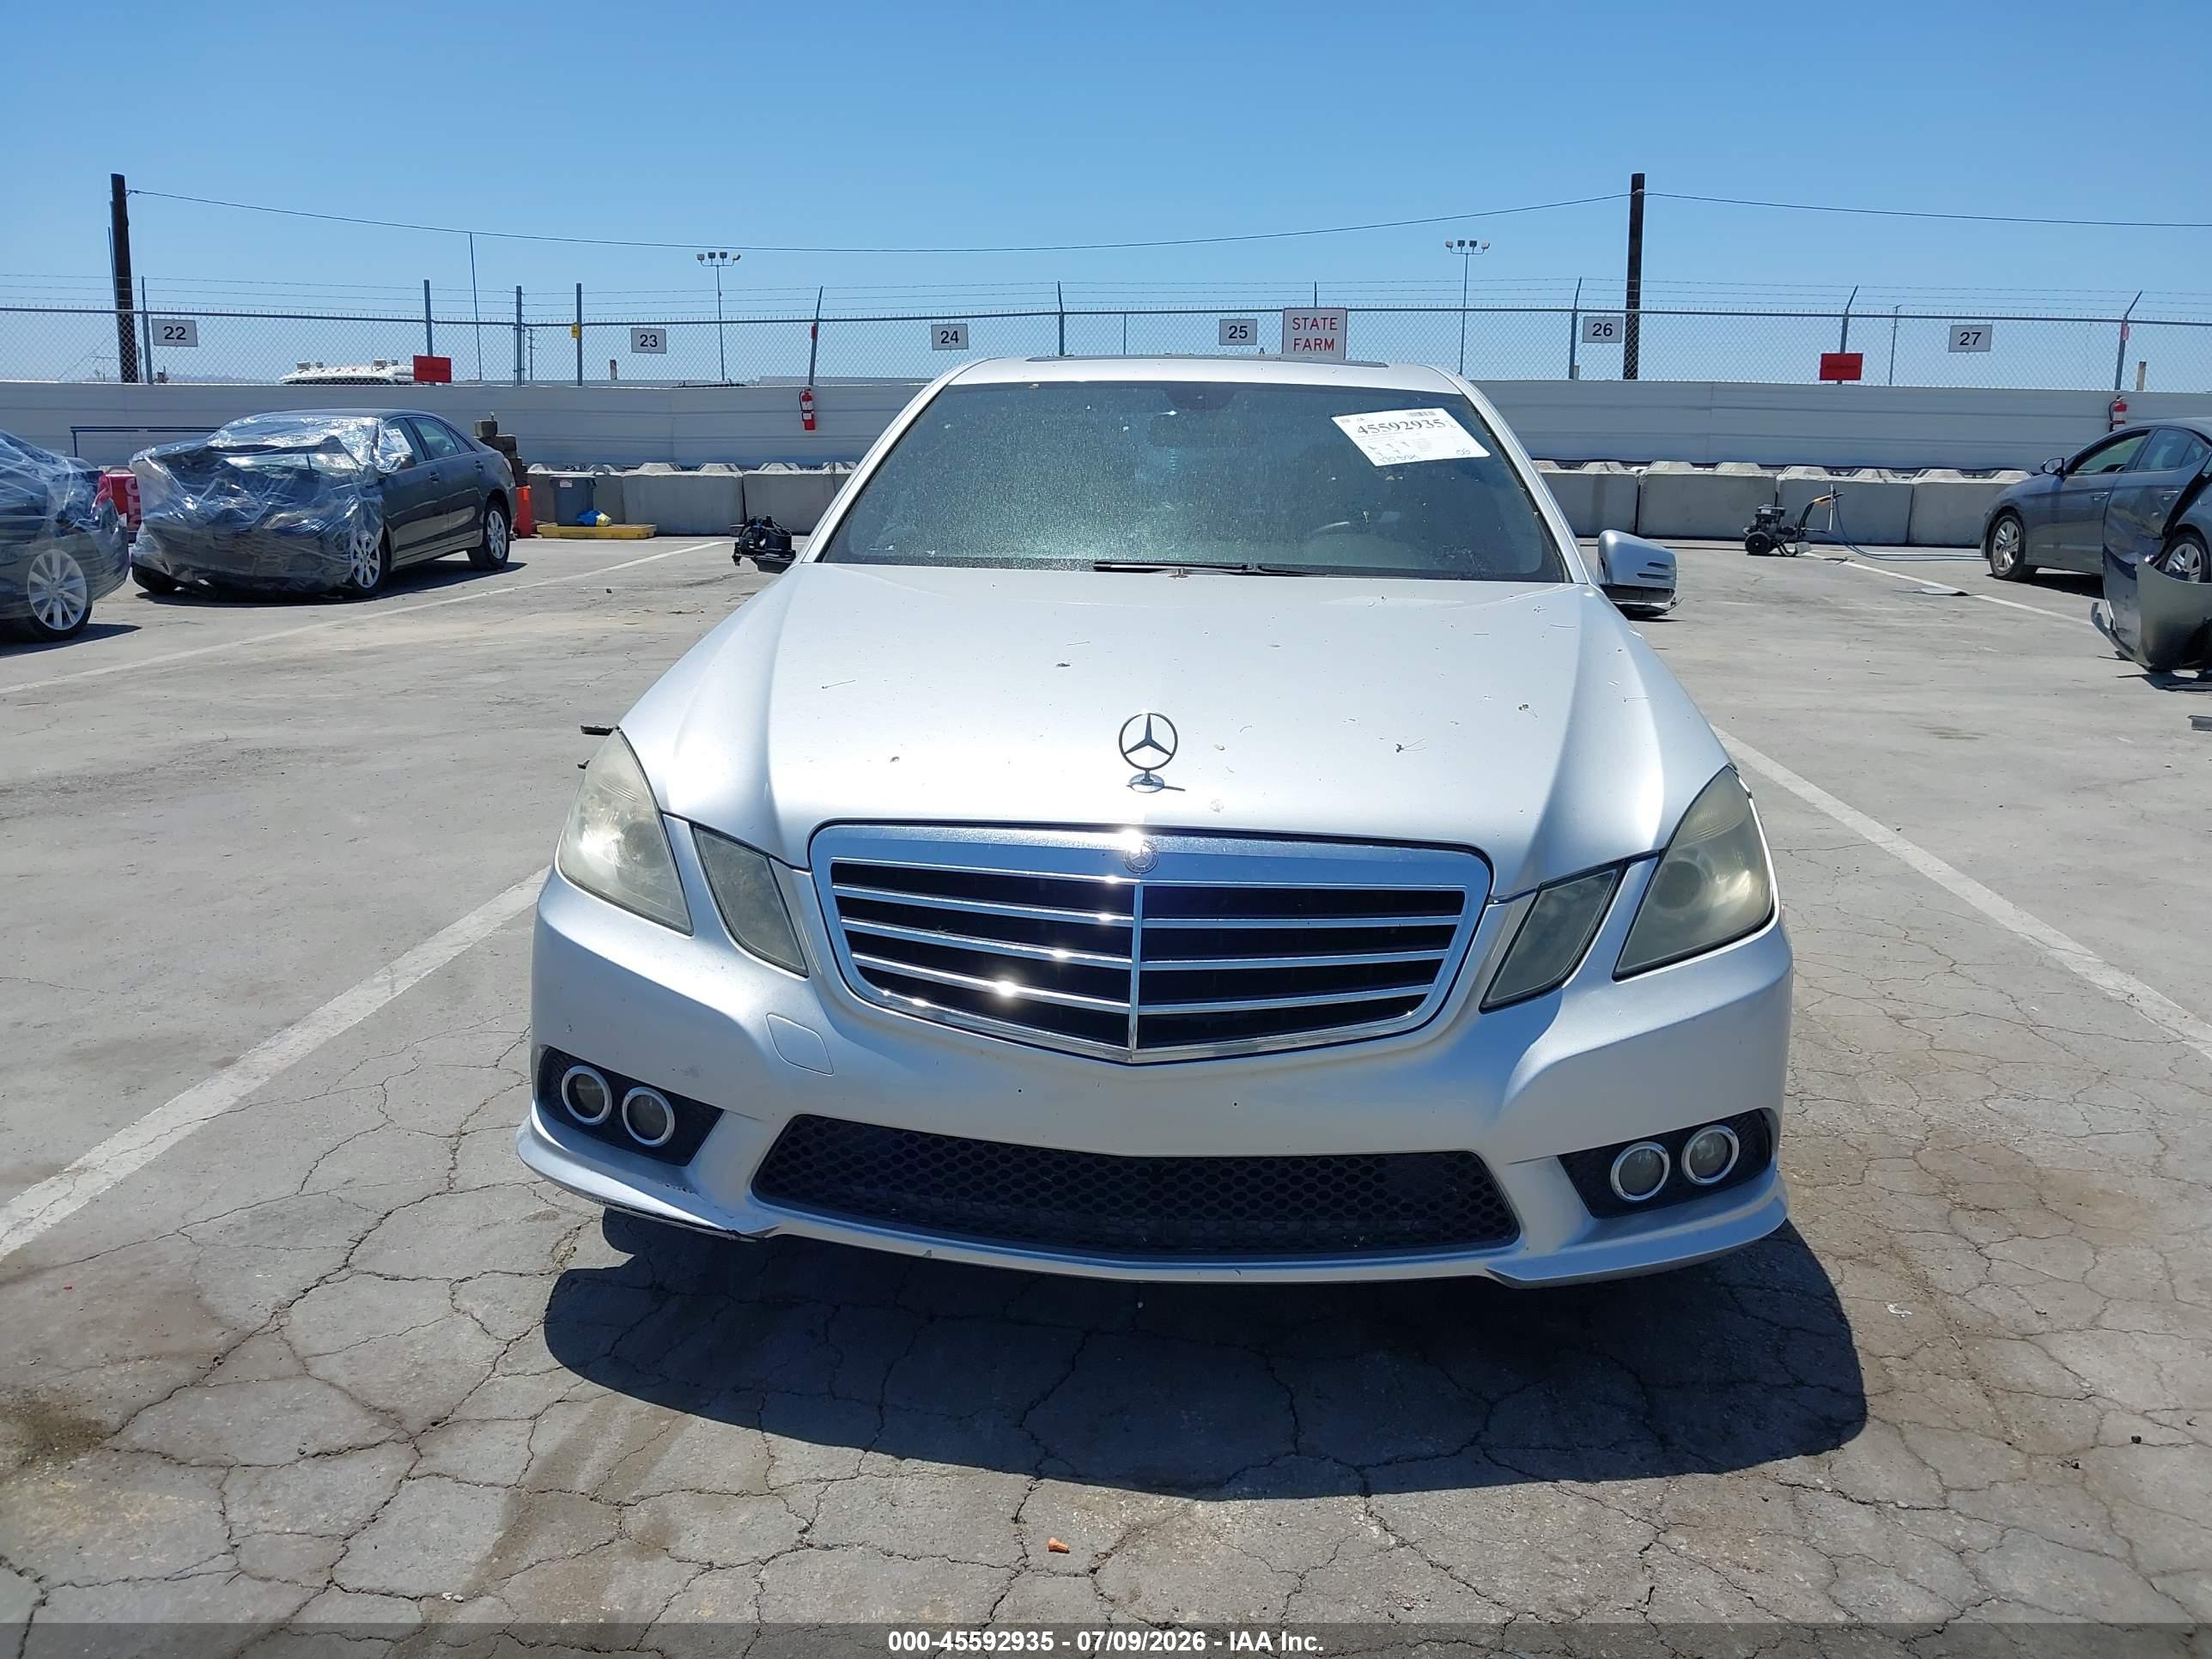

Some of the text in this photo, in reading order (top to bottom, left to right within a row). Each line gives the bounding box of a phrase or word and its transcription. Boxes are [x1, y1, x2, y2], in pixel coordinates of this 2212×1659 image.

[1291, 317, 1339, 331] STATE
[1592, 322, 1613, 337] 26
[163, 325, 186, 340] 22
[940, 330, 959, 344] 24
[1228, 325, 1249, 339] 25
[1959, 331, 1982, 345] 27
[640, 334, 658, 348] 23
[1292, 337, 1335, 351] FARM
[1357, 418, 1446, 434] 45592935
